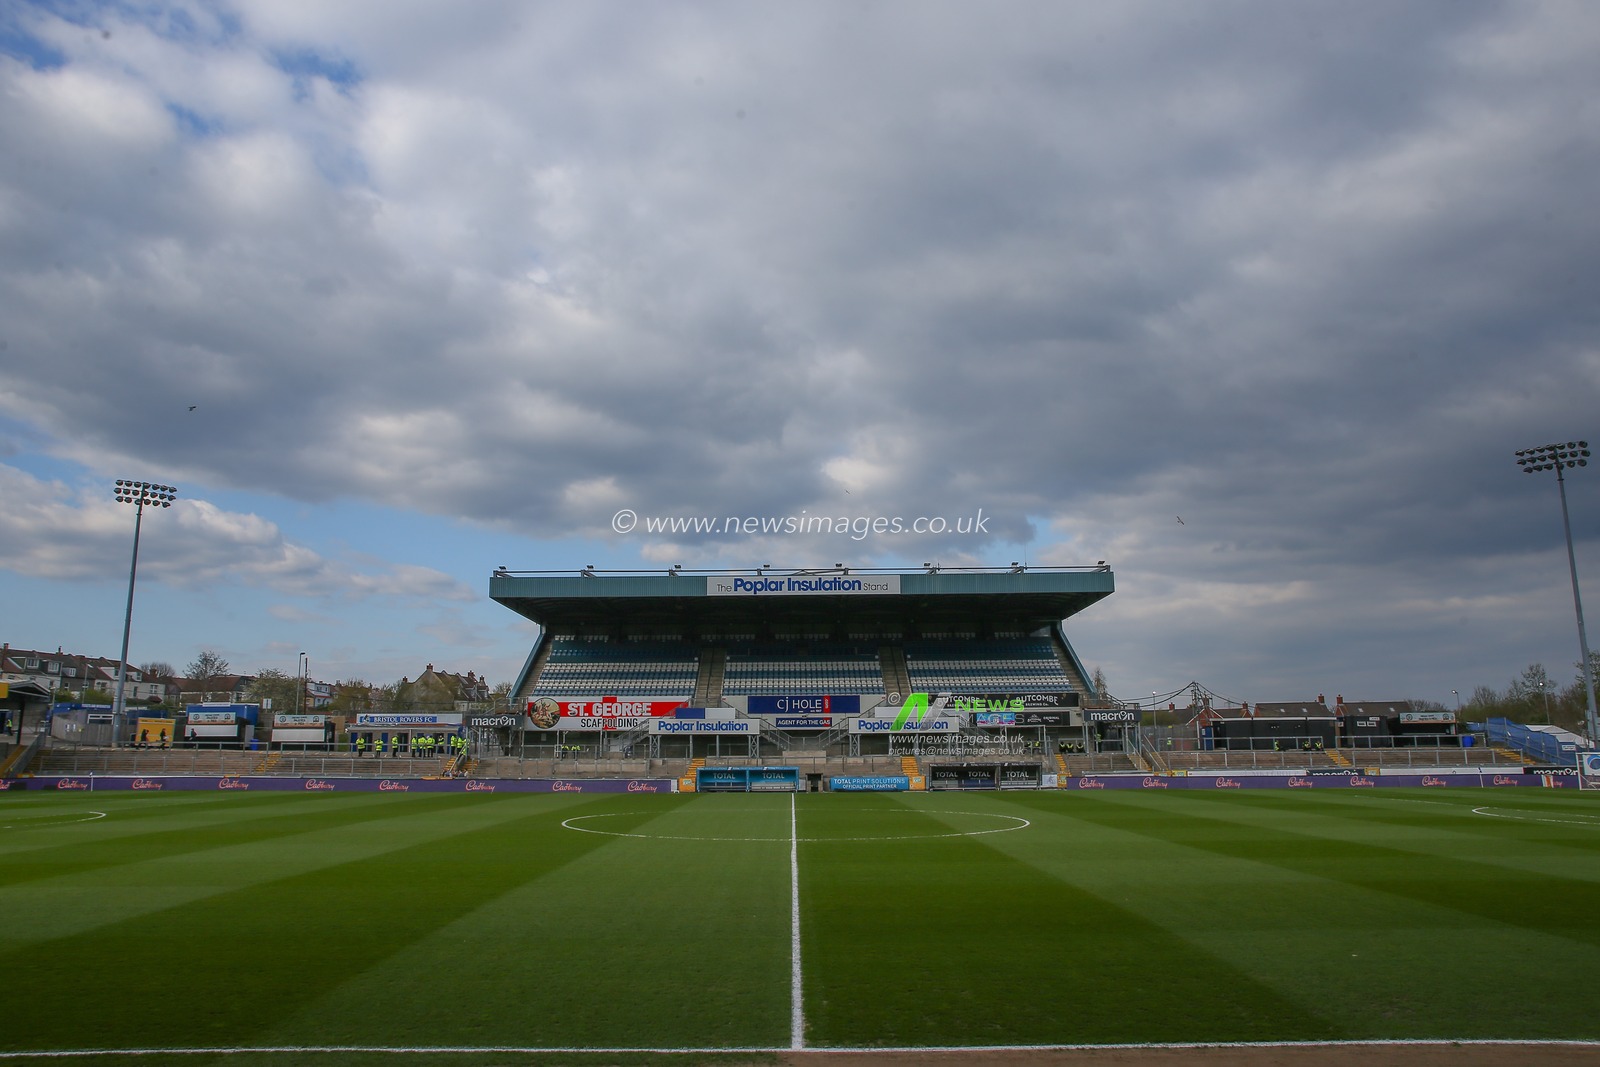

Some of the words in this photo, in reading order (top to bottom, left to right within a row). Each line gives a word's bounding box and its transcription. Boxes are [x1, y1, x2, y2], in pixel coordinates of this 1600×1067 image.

[717, 584, 732, 592] The
[733, 578, 785, 594] Poplar
[787, 577, 862, 591] Insulation
[863, 583, 889, 591] Stand
[567, 702, 589, 717] ST.
[592, 702, 652, 717] GEORGE
[792, 699, 822, 709] HOLE
[471, 715, 516, 726] macron
[1090, 711, 1135, 721] macron
[581, 718, 638, 728] SCAFFOLDING
[658, 721, 694, 733] Poplar
[696, 720, 749, 731] Insulation
[58, 778, 88, 790] Cadbury
[132, 779, 163, 791] Cadbury
[218, 778, 249, 790] Cadbury
[305, 779, 336, 791] Cadbury
[379, 780, 409, 791] Cadbury
[465, 780, 496, 792] Cadbury
[552, 780, 582, 792] Cadbury
[627, 781, 658, 793] Cadbury
[1079, 777, 1105, 789] Cadbury
[1143, 777, 1168, 789] Cadbury
[1216, 777, 1241, 788] Cadbury
[1288, 776, 1313, 788] Cadbury
[1350, 776, 1374, 787] Cadbury
[1422, 775, 1447, 787] Cadbury
